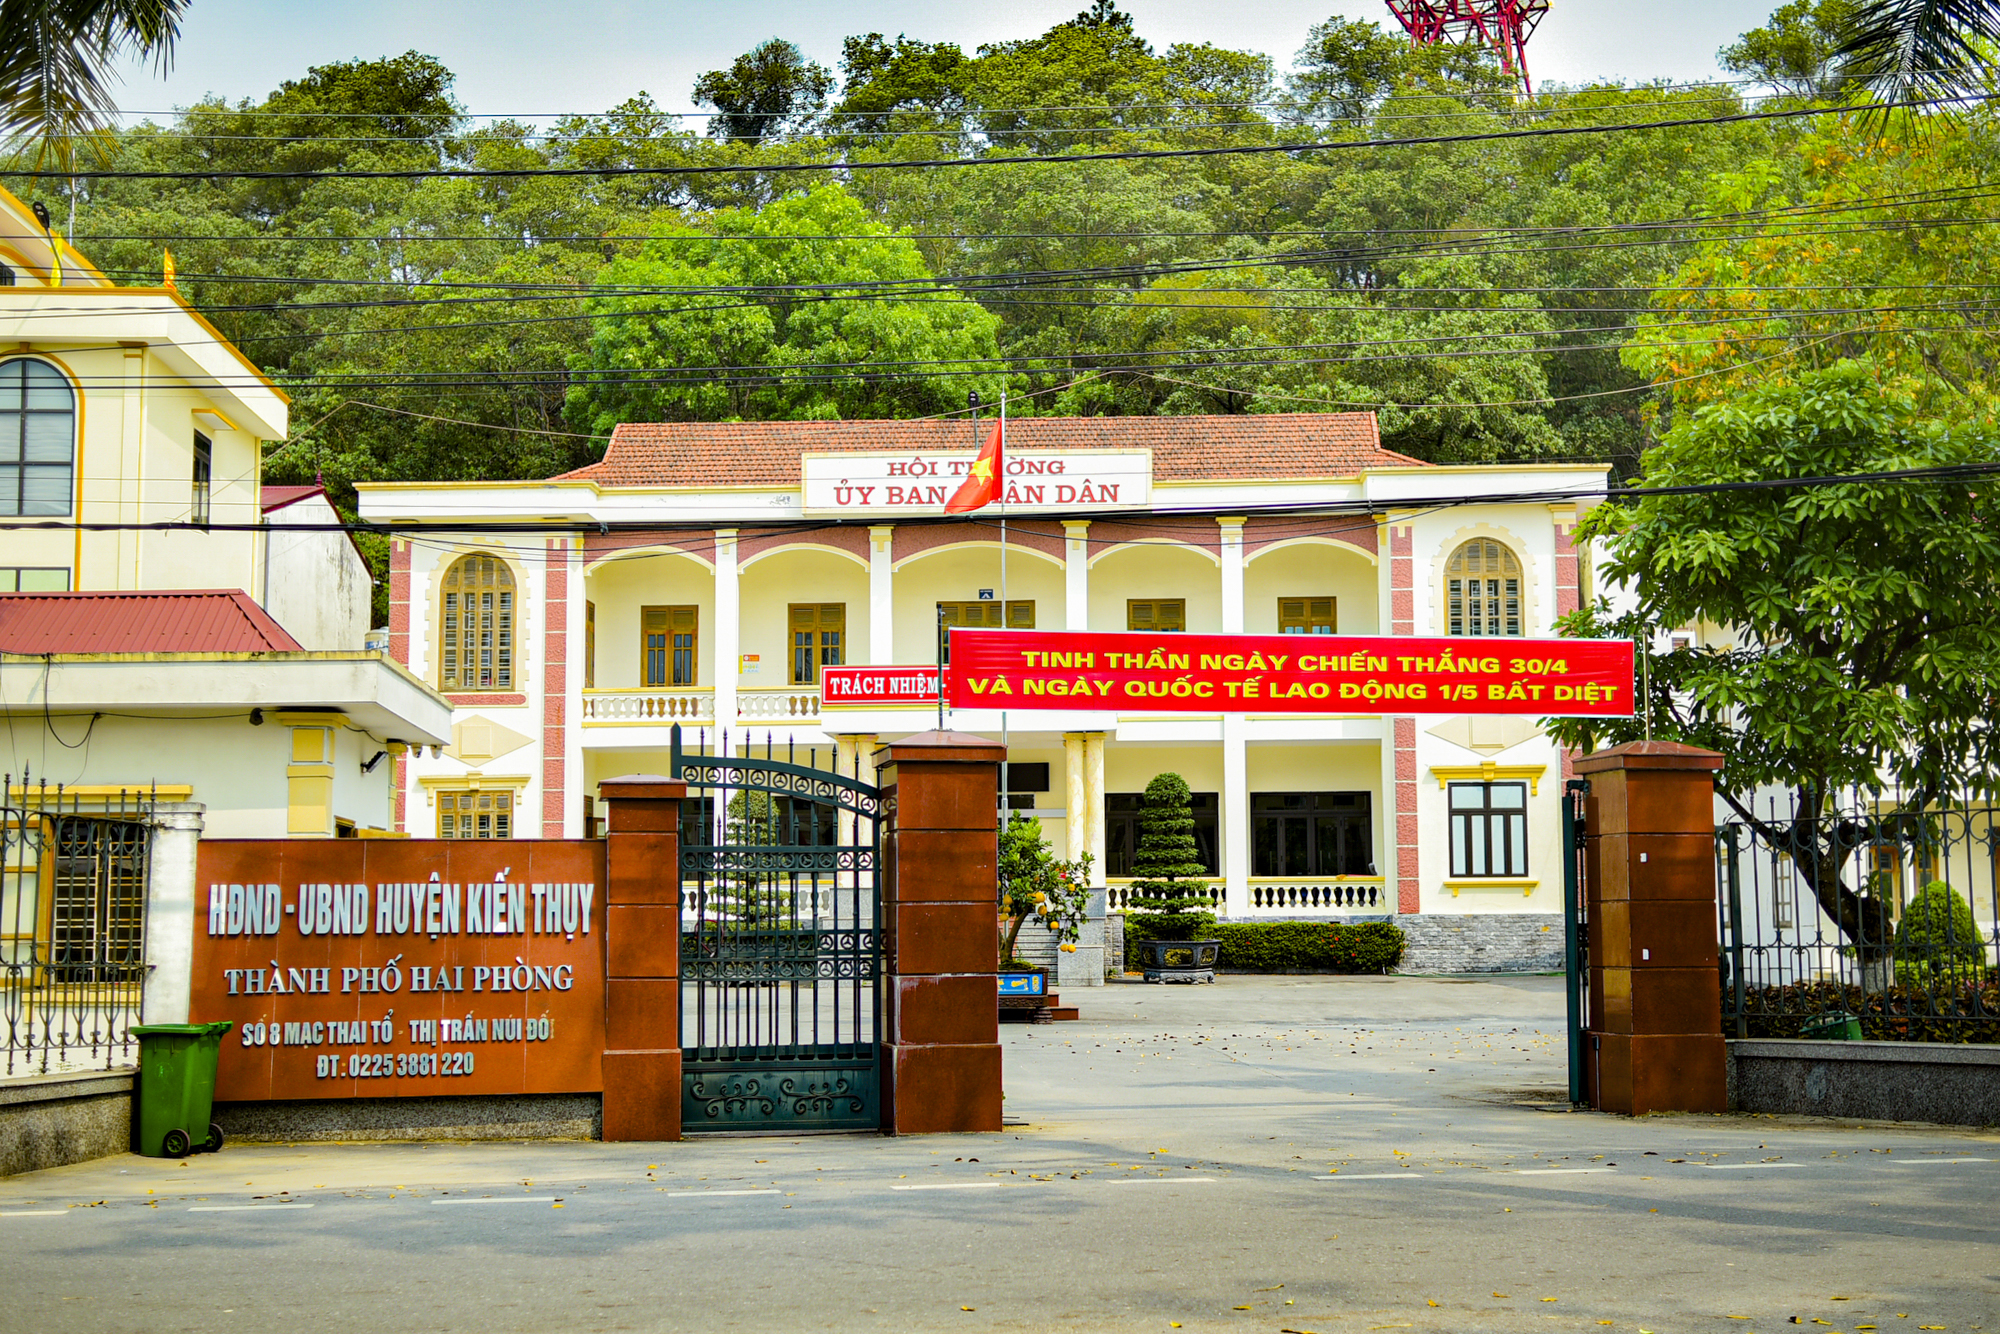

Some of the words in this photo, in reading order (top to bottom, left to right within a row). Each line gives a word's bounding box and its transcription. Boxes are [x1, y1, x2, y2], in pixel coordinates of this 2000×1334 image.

[887, 456, 938, 479] HỘI
[948, 456, 1066, 476] TỜNG
[833, 479, 876, 505] ỦY
[885, 486, 947, 505] BAN
[1055, 478, 1120, 504] DÂN
[1021, 651, 1095, 669] TINH
[1104, 647, 1190, 670] THẦN
[1200, 650, 1289, 671] NGÀY
[1298, 649, 1388, 672] CHIẾN
[1397, 647, 1500, 674] THẮNG
[1509, 658, 1569, 675] 30/4
[829, 673, 885, 695] TRÁCH
[889, 672, 939, 698] NHIỆM
[966, 674, 1013, 695] VÀ
[1023, 675, 1115, 696] NGÀY
[1124, 674, 1214, 698] QUỐC
[1222, 675, 1263, 698] TẾ
[1269, 682, 1331, 699] LAO
[1338, 679, 1428, 704] ĐỘNG
[1438, 684, 1479, 702] 1/5
[1487, 678, 1547, 701] BẤT
[1554, 681, 1618, 706] DIỆT
[208, 884, 281, 935] HĐND
[298, 883, 370, 935] UBND
[376, 872, 461, 939] HUYỆN
[466, 867, 526, 935] KIẾN
[531, 883, 595, 940] THỤY
[224, 960, 331, 994] THÀNH
[341, 954, 403, 993] PHỐ
[410, 966, 465, 992] HAI
[473, 956, 574, 992] PHÒNG
[269, 1022, 281, 1046] 8
[371, 1008, 394, 1043] TỔ
[409, 1019, 437, 1046] THỊ
[441, 1010, 488, 1042] TRẤN
[349, 1053, 394, 1077] 0225
[396, 1052, 438, 1077] 3881
[441, 1051, 475, 1076] 220
